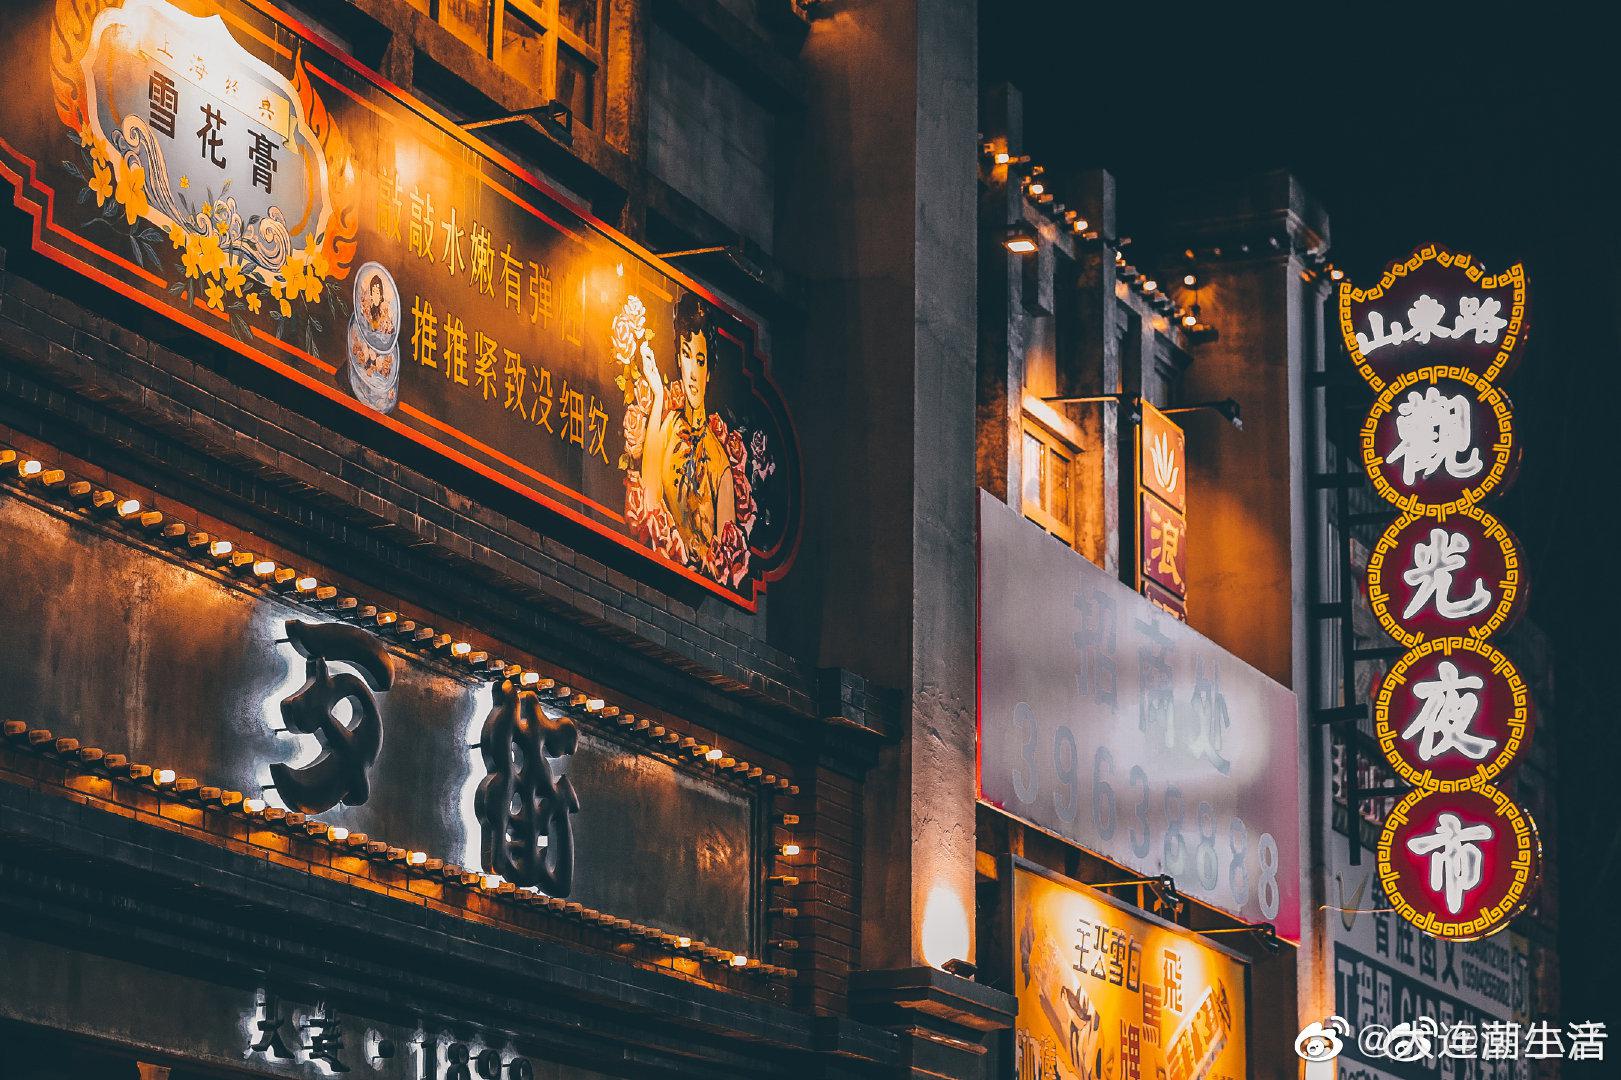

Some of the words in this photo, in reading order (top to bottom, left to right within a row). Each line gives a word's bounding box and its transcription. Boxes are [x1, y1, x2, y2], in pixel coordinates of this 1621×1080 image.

[149, 70, 280, 195] 雪花膏
[410, 295, 610, 465] 推推紧致没细纹
[1012, 702, 1280, 920] 39638888
